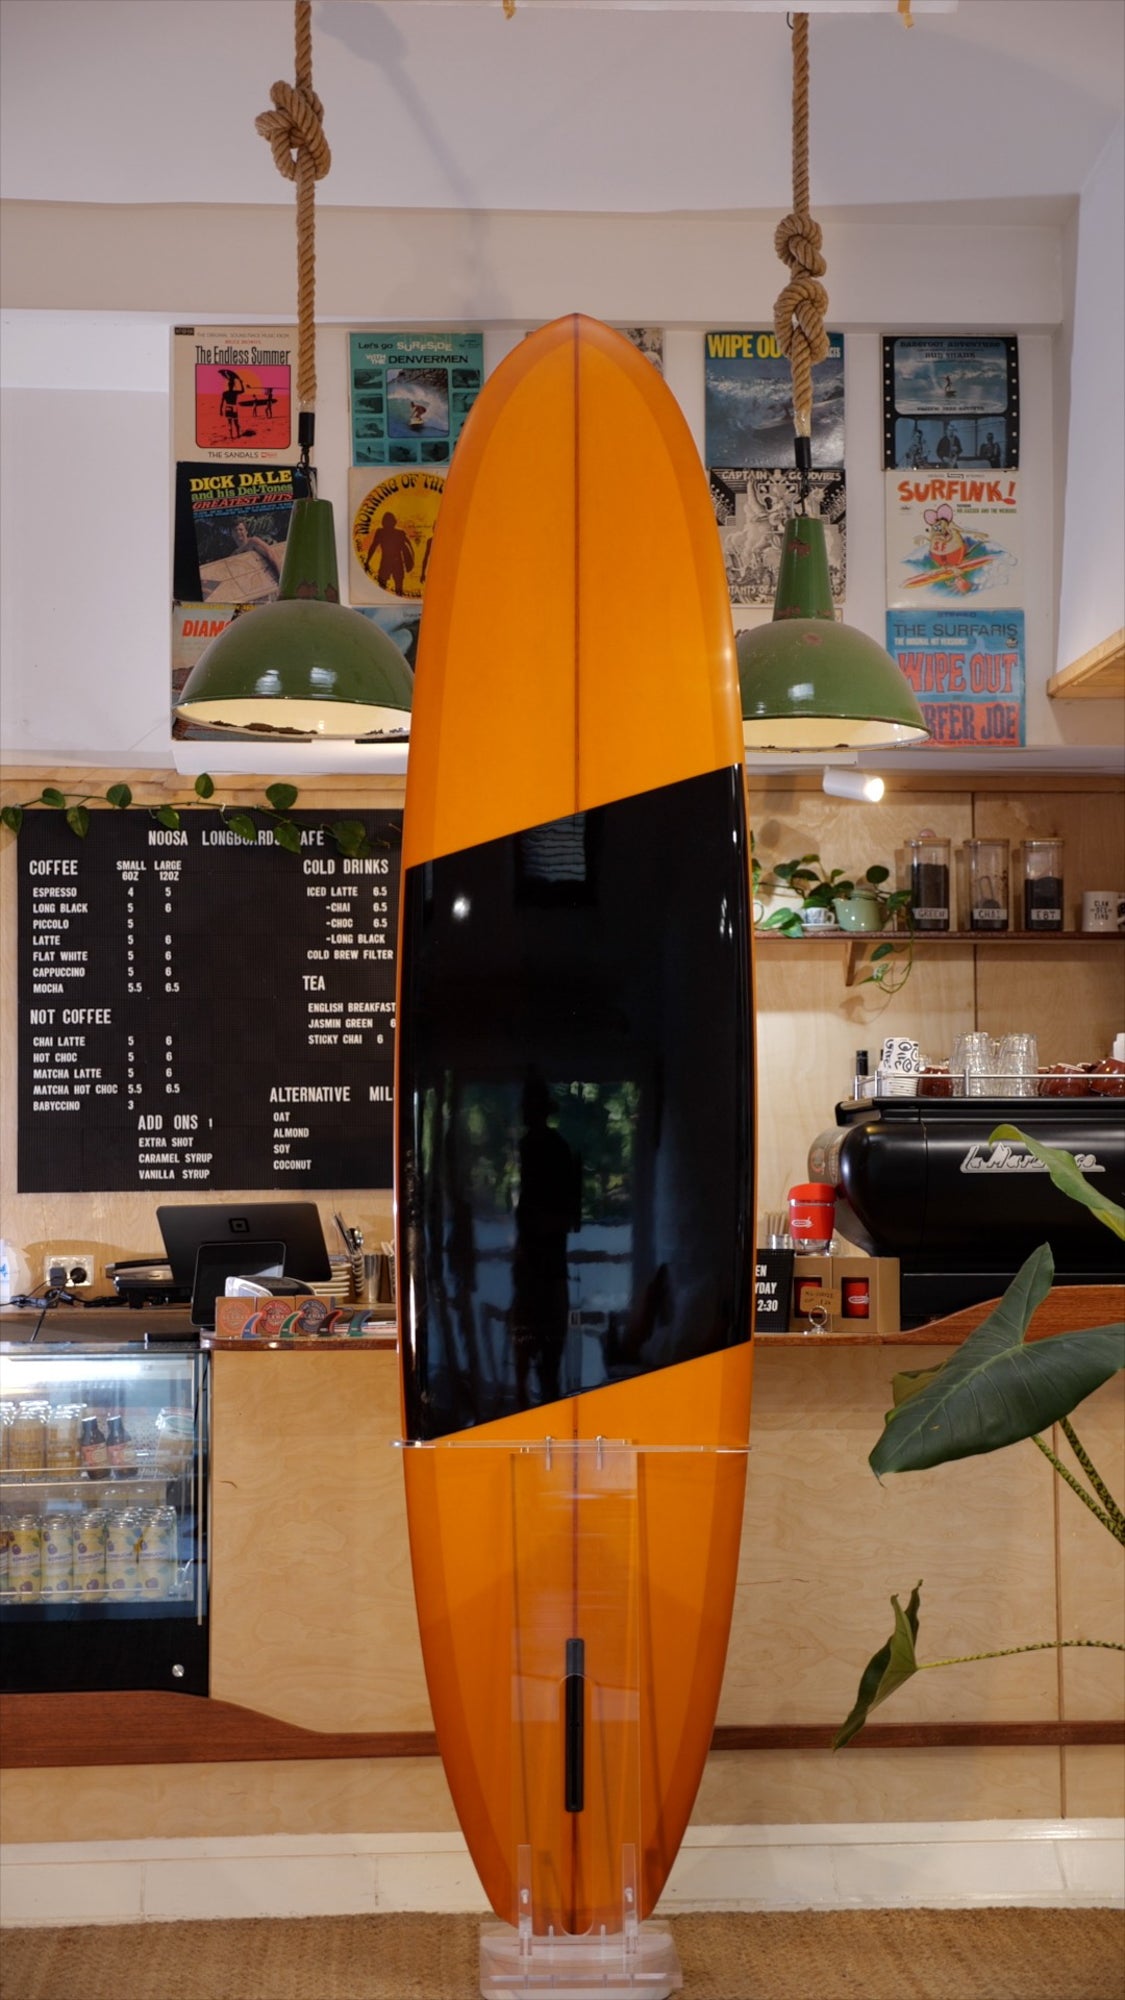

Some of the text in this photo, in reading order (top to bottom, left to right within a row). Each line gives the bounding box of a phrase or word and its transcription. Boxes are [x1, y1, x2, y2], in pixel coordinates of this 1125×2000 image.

[396, 341, 453, 351] SURFSIDE
[707, 334, 783, 359] WIPE OU
[195, 345, 291, 365] The Endless Summer
[388, 355, 468, 364] DENVERMEN
[189, 469, 292, 492] DICK DALE
[721, 471, 768, 480] CAPTAIN
[191, 483, 293, 501] and his Del-Tones
[897, 479, 1016, 505] SURFINK!
[192, 496, 260, 511] GREATEST
[263, 493, 294, 503] HITS
[356, 477, 399, 536] MORNING
[401, 473, 420, 489] OF
[728, 585, 756, 594] TANTS
[182, 619, 232, 638] DIAM
[893, 624, 1018, 637] THE SURFARIS
[897, 651, 1019, 693] WIPE OUT
[921, 704, 1017, 740] RFER JOE
[149, 831, 188, 845] NOOSA
[300, 831, 324, 845] AFE
[30, 860, 78, 875] COFFEE
[117, 861, 181, 870] SMALL LARGE
[304, 859, 388, 874] COLD DRINKS
[33, 887, 171, 897] ESPRESSO 4 5
[307, 887, 387, 896] ICED LATTE 6.5
[33, 903, 171, 913] LONG BLACK 5 6
[373, 902, 387, 912] 6.5
[33, 919, 133, 929] PICCOLO 5
[373, 918, 387, 928] 6.5
[33, 935, 171, 945] LATTE 5 6
[358, 934, 385, 944] BLACK
[33, 951, 171, 961] FLAT WHITE 5 6
[307, 950, 393, 960] COLD BREW FILTER
[33, 967, 171, 977] CAPPUCCINO 5 6
[33, 983, 179, 993] MOCHA 5.5 6.5
[302, 976, 325, 990] TEA
[308, 1002, 396, 1012] ENGLISH BREAKFAST
[30, 1009, 111, 1024] NOT COFFEE
[308, 1019, 396, 1028] JASMIN GREEN 6
[33, 1036, 172, 1047] CHAI LATTE 5 6
[308, 1034, 383, 1044] STICKY CHAI 6
[33, 1052, 172, 1063] HOT CHOC 5 6
[33, 1068, 172, 1079] MATCHA LATTE 5 6
[33, 1084, 180, 1095] MATCHA HOT CHOC 5.5 6.5
[270, 1086, 395, 1102] ALTERNATIVE MIL
[33, 1100, 134, 1111] BABYCCINO 3
[273, 1112, 290, 1122] OAT
[138, 1115, 162, 1130] ADD
[174, 1115, 198, 1130] ONS
[274, 1128, 309, 1138] ALMOND
[139, 1137, 193, 1147] EXTRA SHOT
[274, 1144, 290, 1154] SOY
[139, 1153, 212, 1163] CARAMEL SYRUP
[273, 1160, 311, 1170] COCONUT
[139, 1169, 210, 1179] VANILLA SYRUP
[755, 1264, 767, 1277] EN
[754, 1282, 777, 1294] YDAY
[757, 1300, 778, 1311] 2:30
